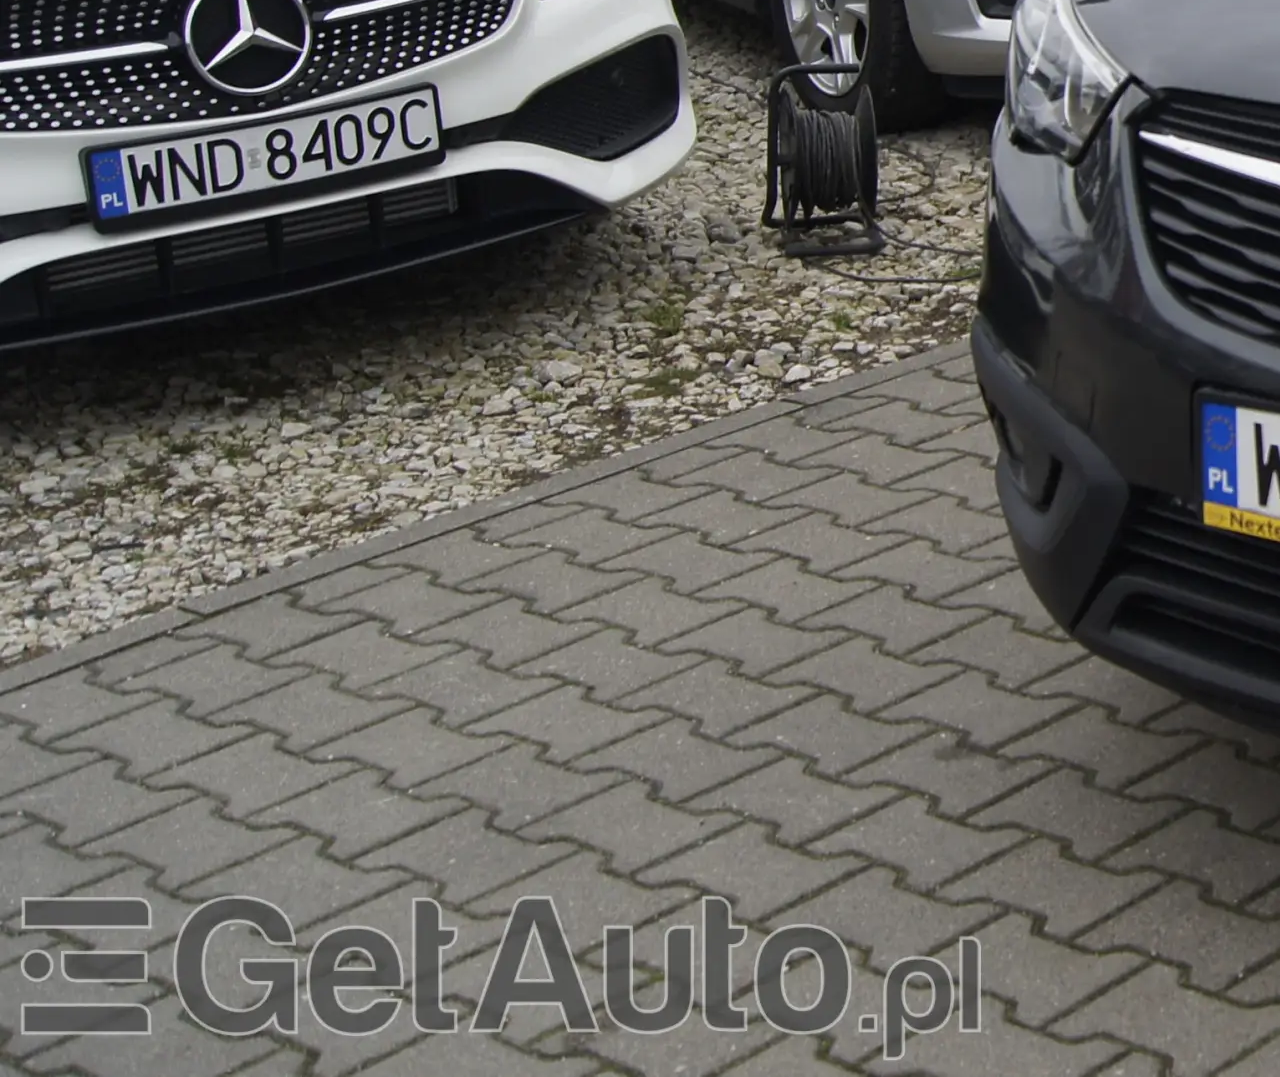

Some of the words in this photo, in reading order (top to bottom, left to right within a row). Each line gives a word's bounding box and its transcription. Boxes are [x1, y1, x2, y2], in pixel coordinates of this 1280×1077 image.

[127, 138, 245, 208] WND
[265, 98, 433, 181] 8409C
[100, 193, 124, 210] PL
[1208, 467, 1234, 494] PL
